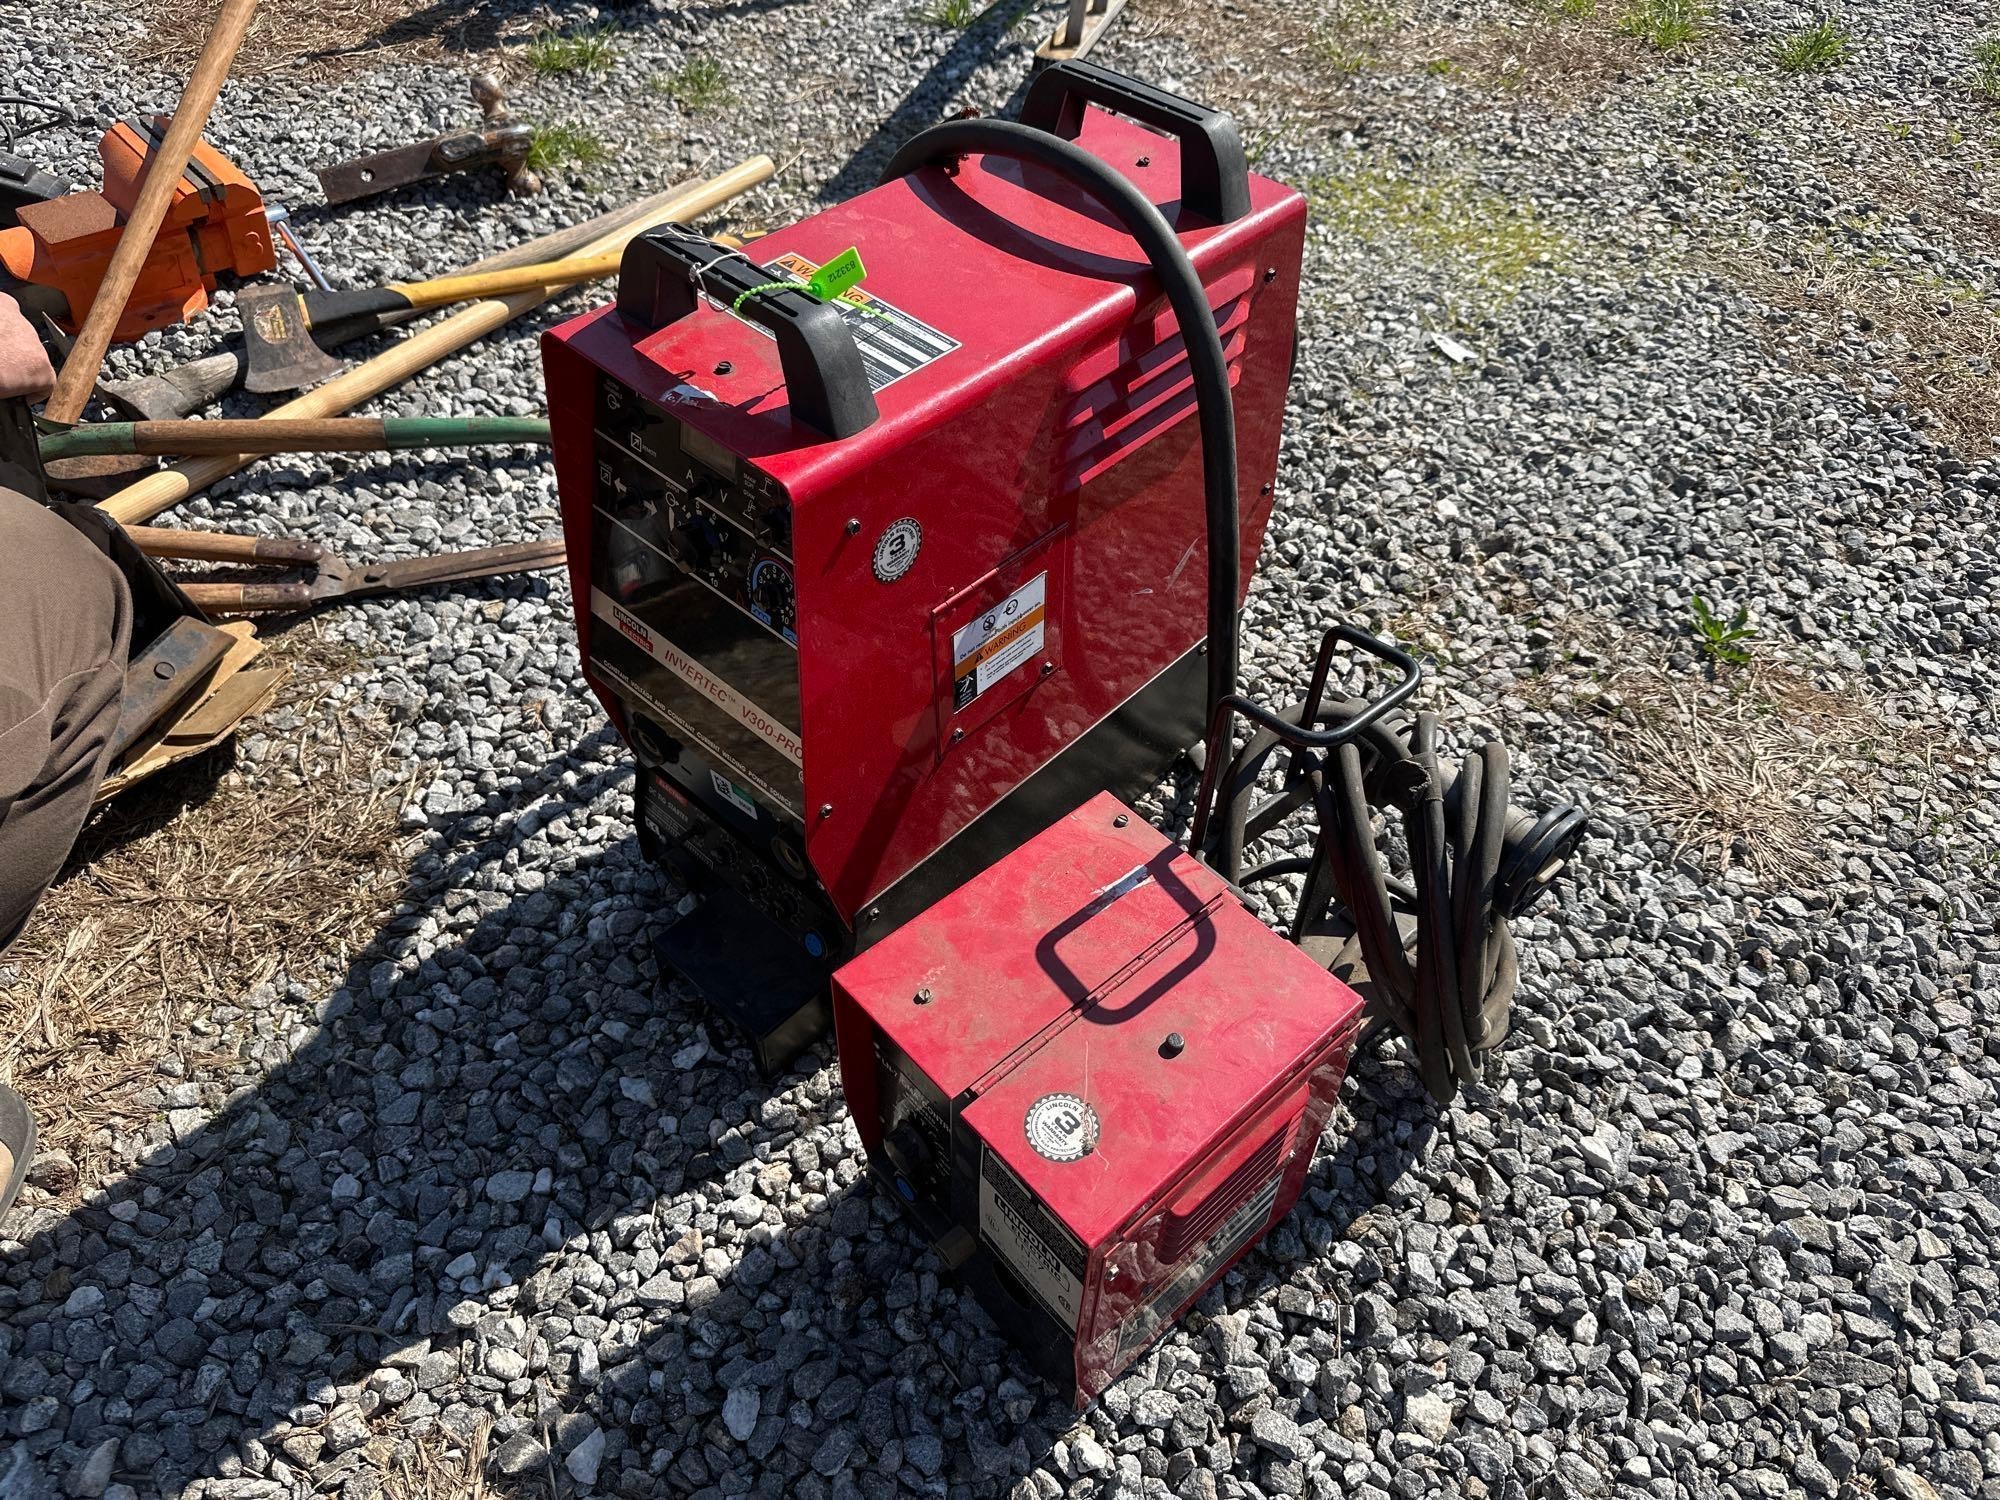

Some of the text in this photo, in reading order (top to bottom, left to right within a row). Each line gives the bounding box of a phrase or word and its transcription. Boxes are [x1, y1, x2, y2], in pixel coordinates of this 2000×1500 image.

[827, 260, 856, 283] 833212
[686, 469, 695, 485] A
[719, 488, 728, 504] V
[879, 526, 916, 560] LINCOLN ELECTRIC
[889, 533, 906, 556] 3
[711, 578, 720, 588] 10
[723, 569, 730, 579] 9
[614, 606, 648, 639] LINCOLN
[781, 614, 790, 625] 10
[621, 624, 652, 651] ELECTRIC
[984, 621, 1027, 656] WARNING
[603, 659, 629, 682] CONSTANT
[630, 679, 654, 701] VOLTAGE
[654, 698, 666, 711] AND
[667, 709, 696, 733] CONSTANT
[696, 731, 721, 752] CURRENT
[721, 750, 747, 772] WELDING
[747, 770, 768, 789] POWER
[768, 787, 793, 807] SOURCE
[741, 704, 803, 760] V300-PRO
[1045, 1101, 1079, 1112] LINCOLN
[1042, 1120, 1068, 1146] WARRANTY
[1050, 1122, 1068, 1140] YEAR
[1054, 1110, 1081, 1136] 3
[994, 1193, 1061, 1273] LINCOLN
